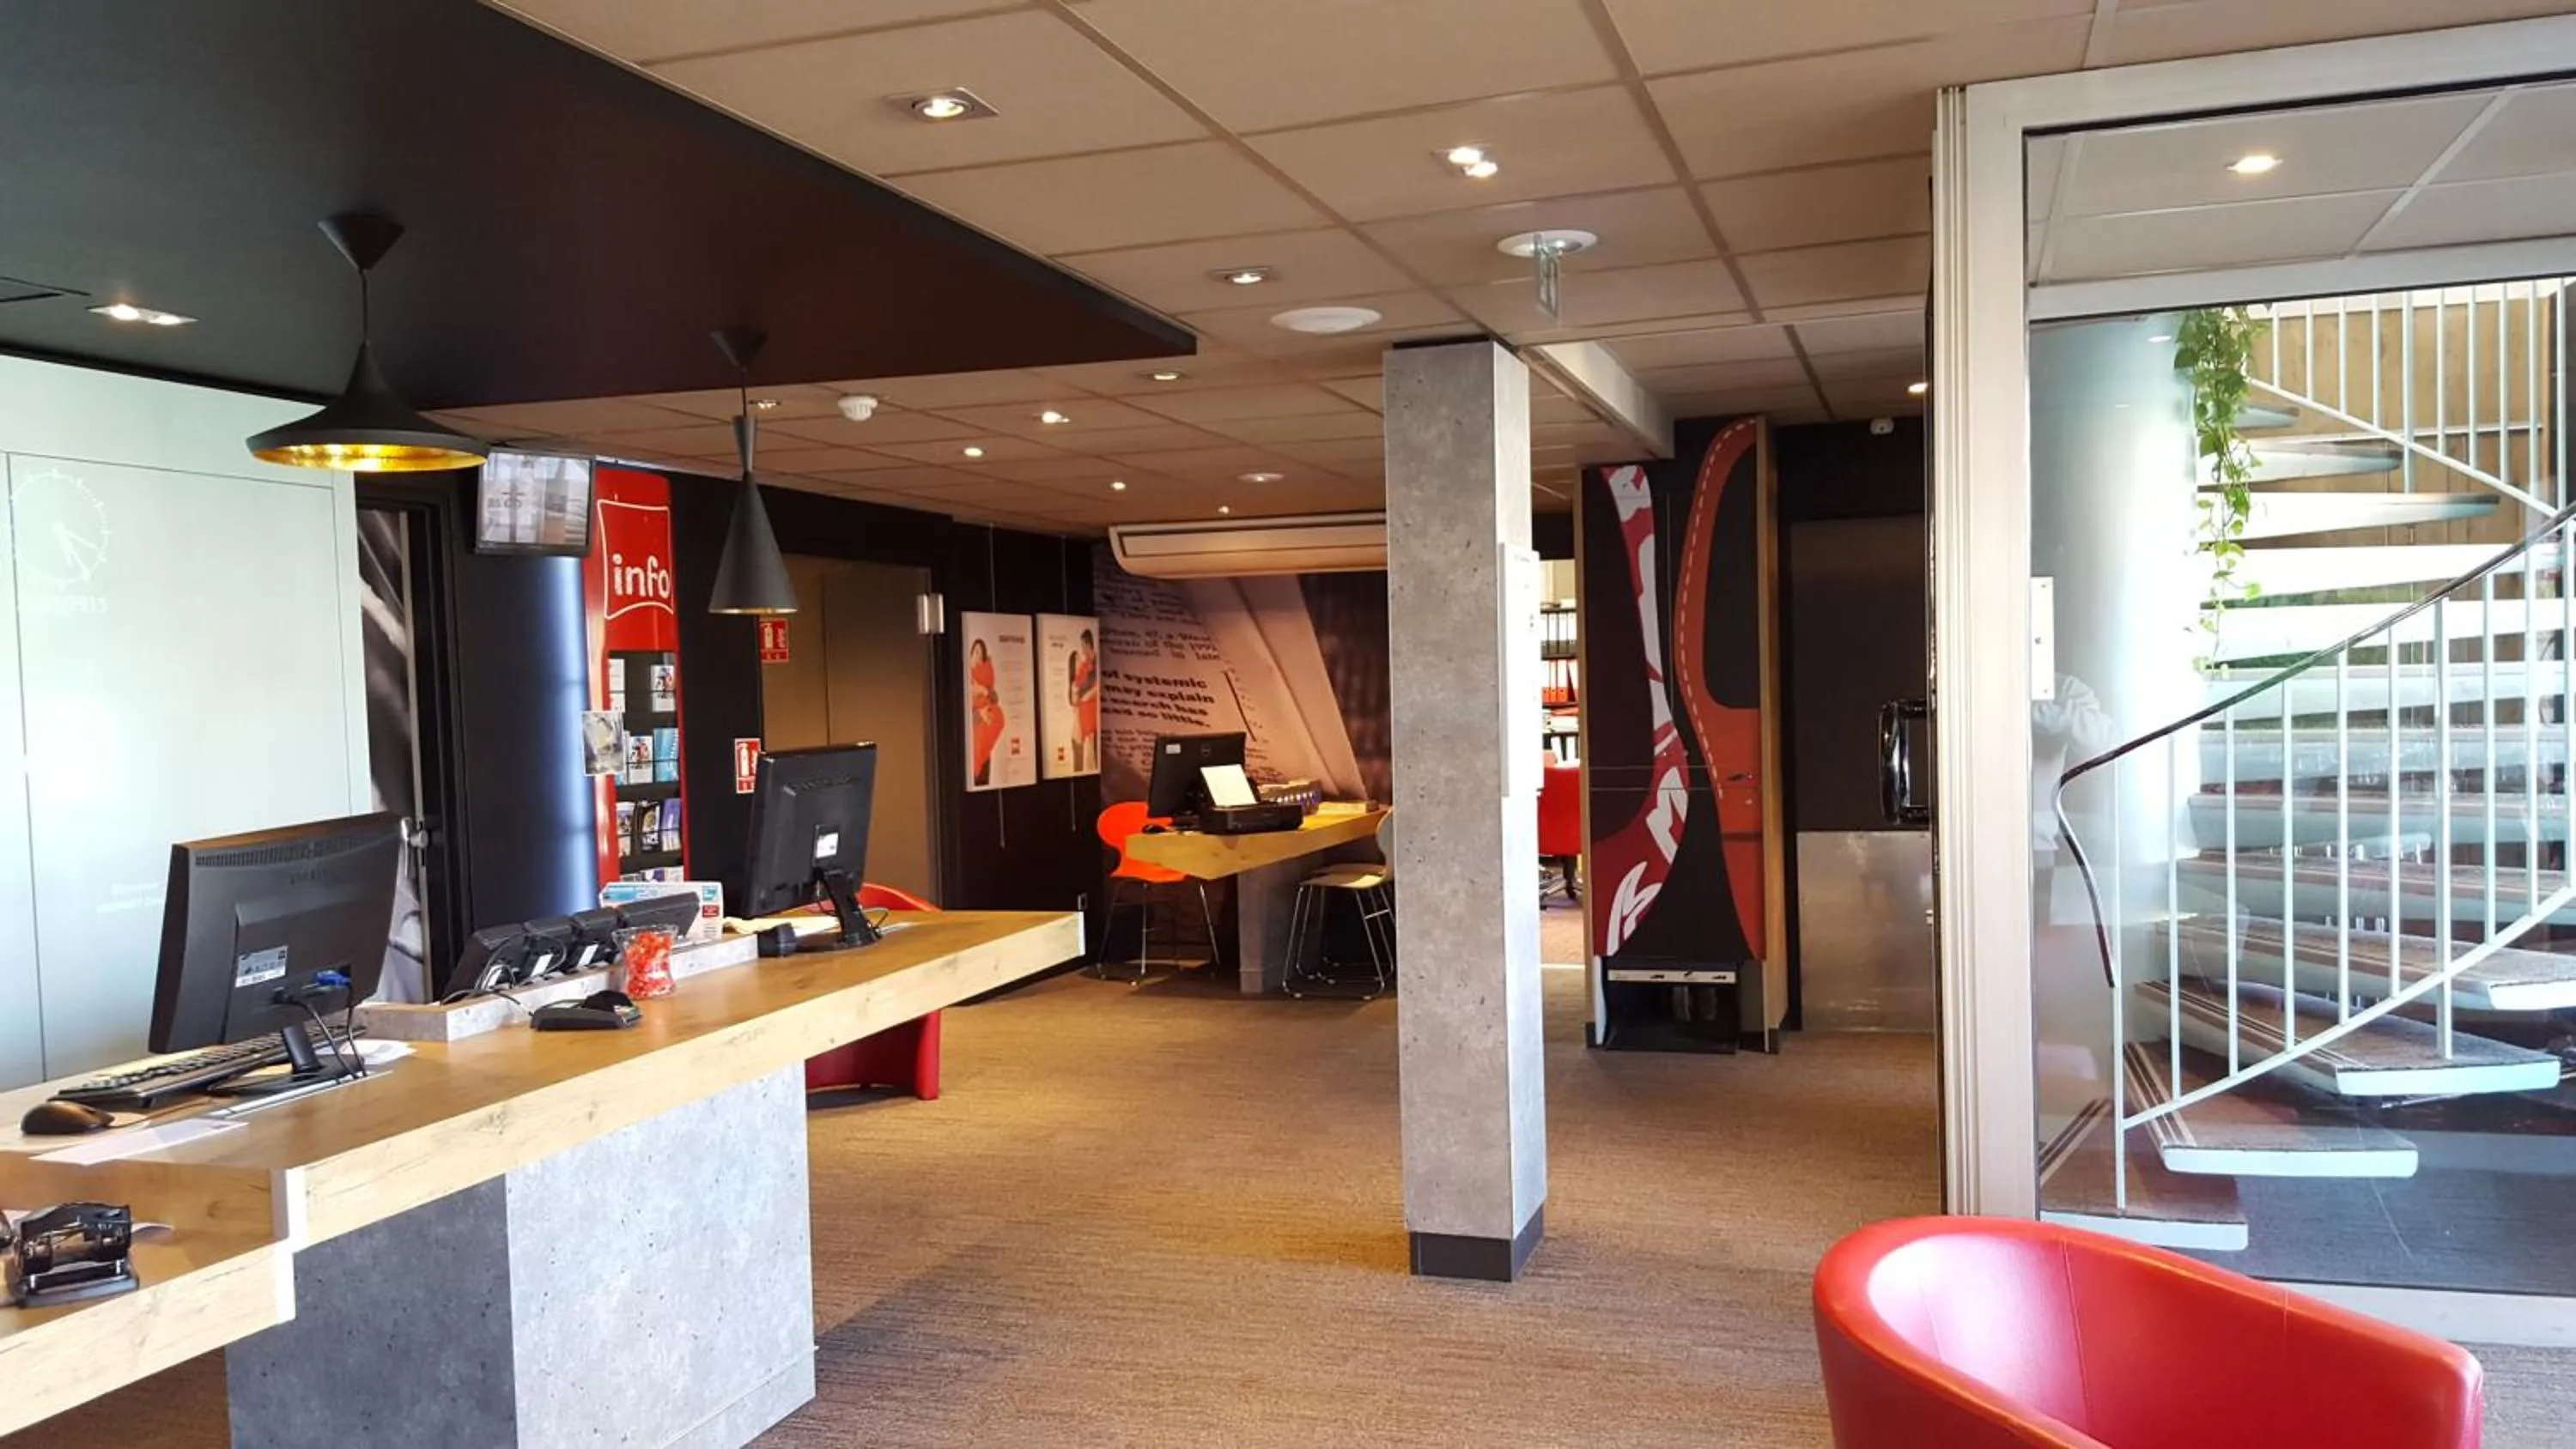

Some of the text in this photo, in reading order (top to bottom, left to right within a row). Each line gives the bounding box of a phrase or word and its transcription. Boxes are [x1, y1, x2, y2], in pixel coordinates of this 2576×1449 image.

[612, 553, 671, 598] info
[1123, 673, 1207, 688] systemic
[1146, 691, 1215, 704] explain
